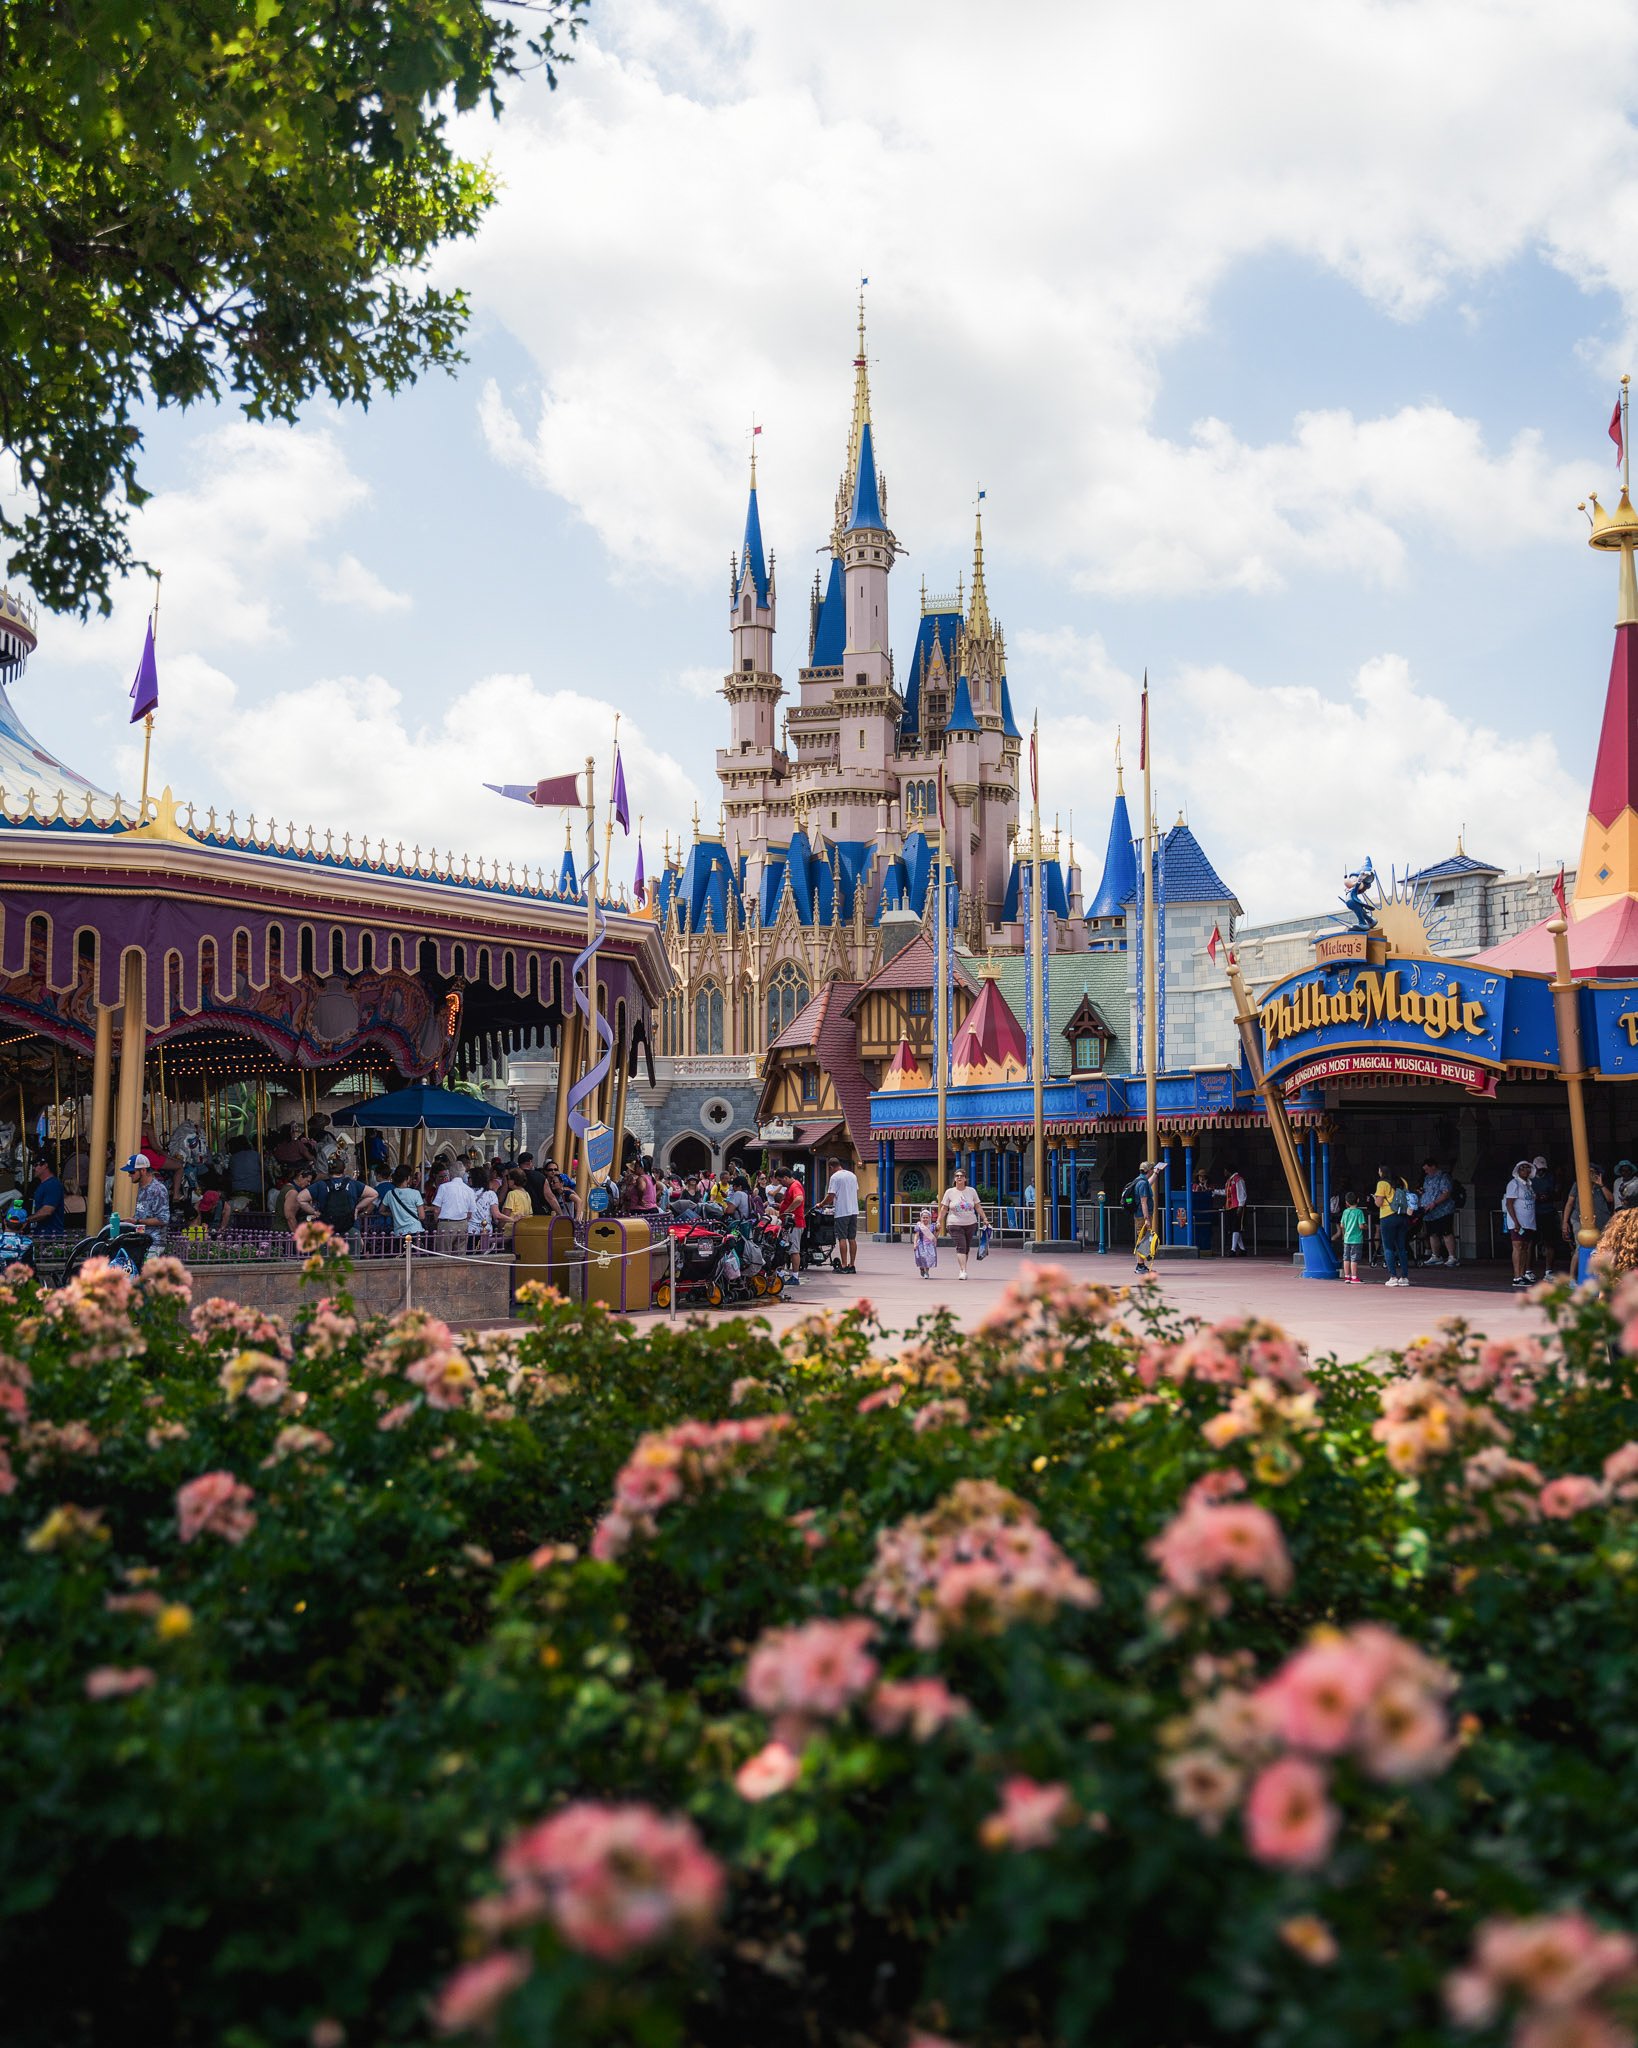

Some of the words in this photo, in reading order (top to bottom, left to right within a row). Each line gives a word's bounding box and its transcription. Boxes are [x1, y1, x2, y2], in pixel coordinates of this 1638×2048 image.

[1319, 938, 1362, 957] Mickey's
[1259, 969, 1488, 1051] PhilharMagic
[1285, 1076, 1295, 1091] THE
[1294, 1062, 1327, 1085] KINGDOM'S
[1328, 1058, 1351, 1072] MOST
[1352, 1056, 1392, 1069] MAGICAL
[1394, 1057, 1438, 1074] MUSICAL
[1440, 1063, 1476, 1082] REVUE
